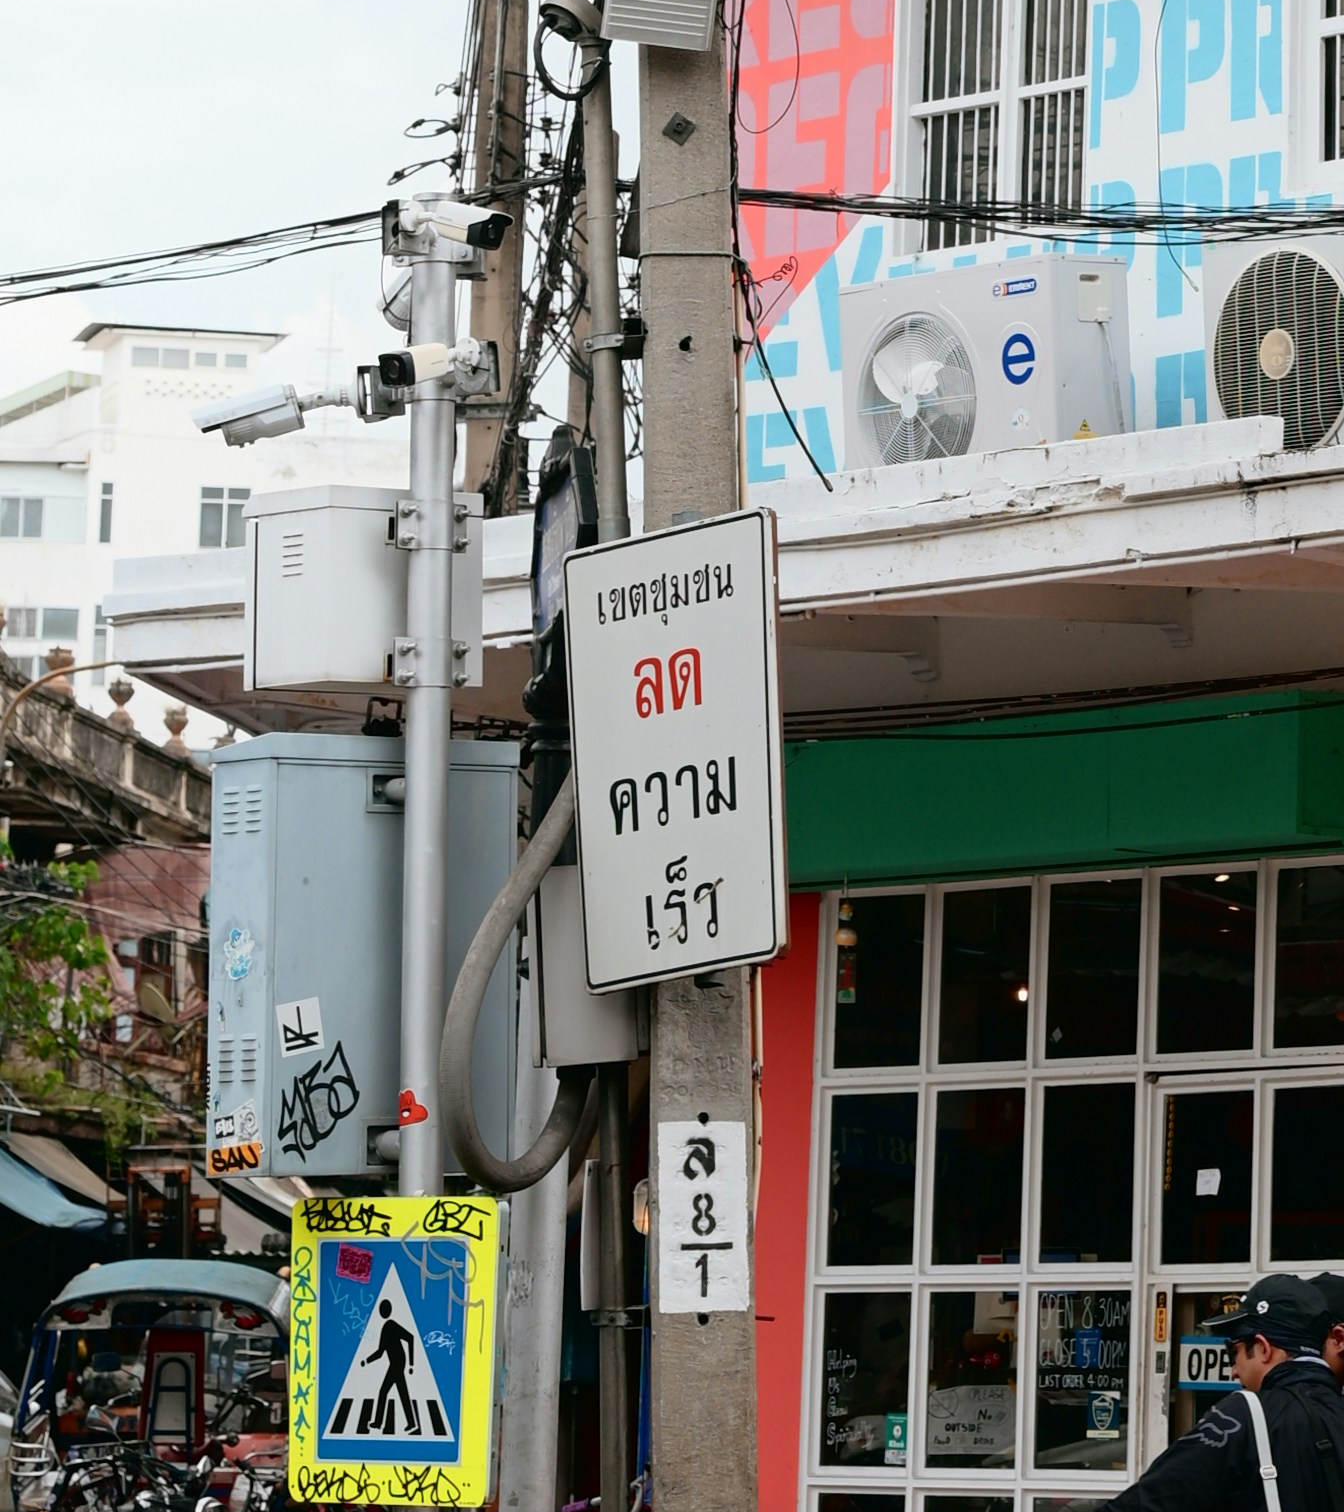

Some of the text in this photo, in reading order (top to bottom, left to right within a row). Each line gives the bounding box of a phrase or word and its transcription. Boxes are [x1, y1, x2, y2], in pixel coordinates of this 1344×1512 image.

[598, 563, 735, 625] เขตชุมชน
[632, 647, 703, 719] ลด
[608, 756, 738, 835] ความ
[644, 854, 724, 950] เร็ว
[1039, 1293, 1074, 1330] OPEN
[1038, 1338, 1077, 1368] CLOSE
[1187, 1348, 1236, 1382] OPE
[1038, 1374, 1061, 1388] LAST
[944, 1422, 982, 1433] OUTSIDE
